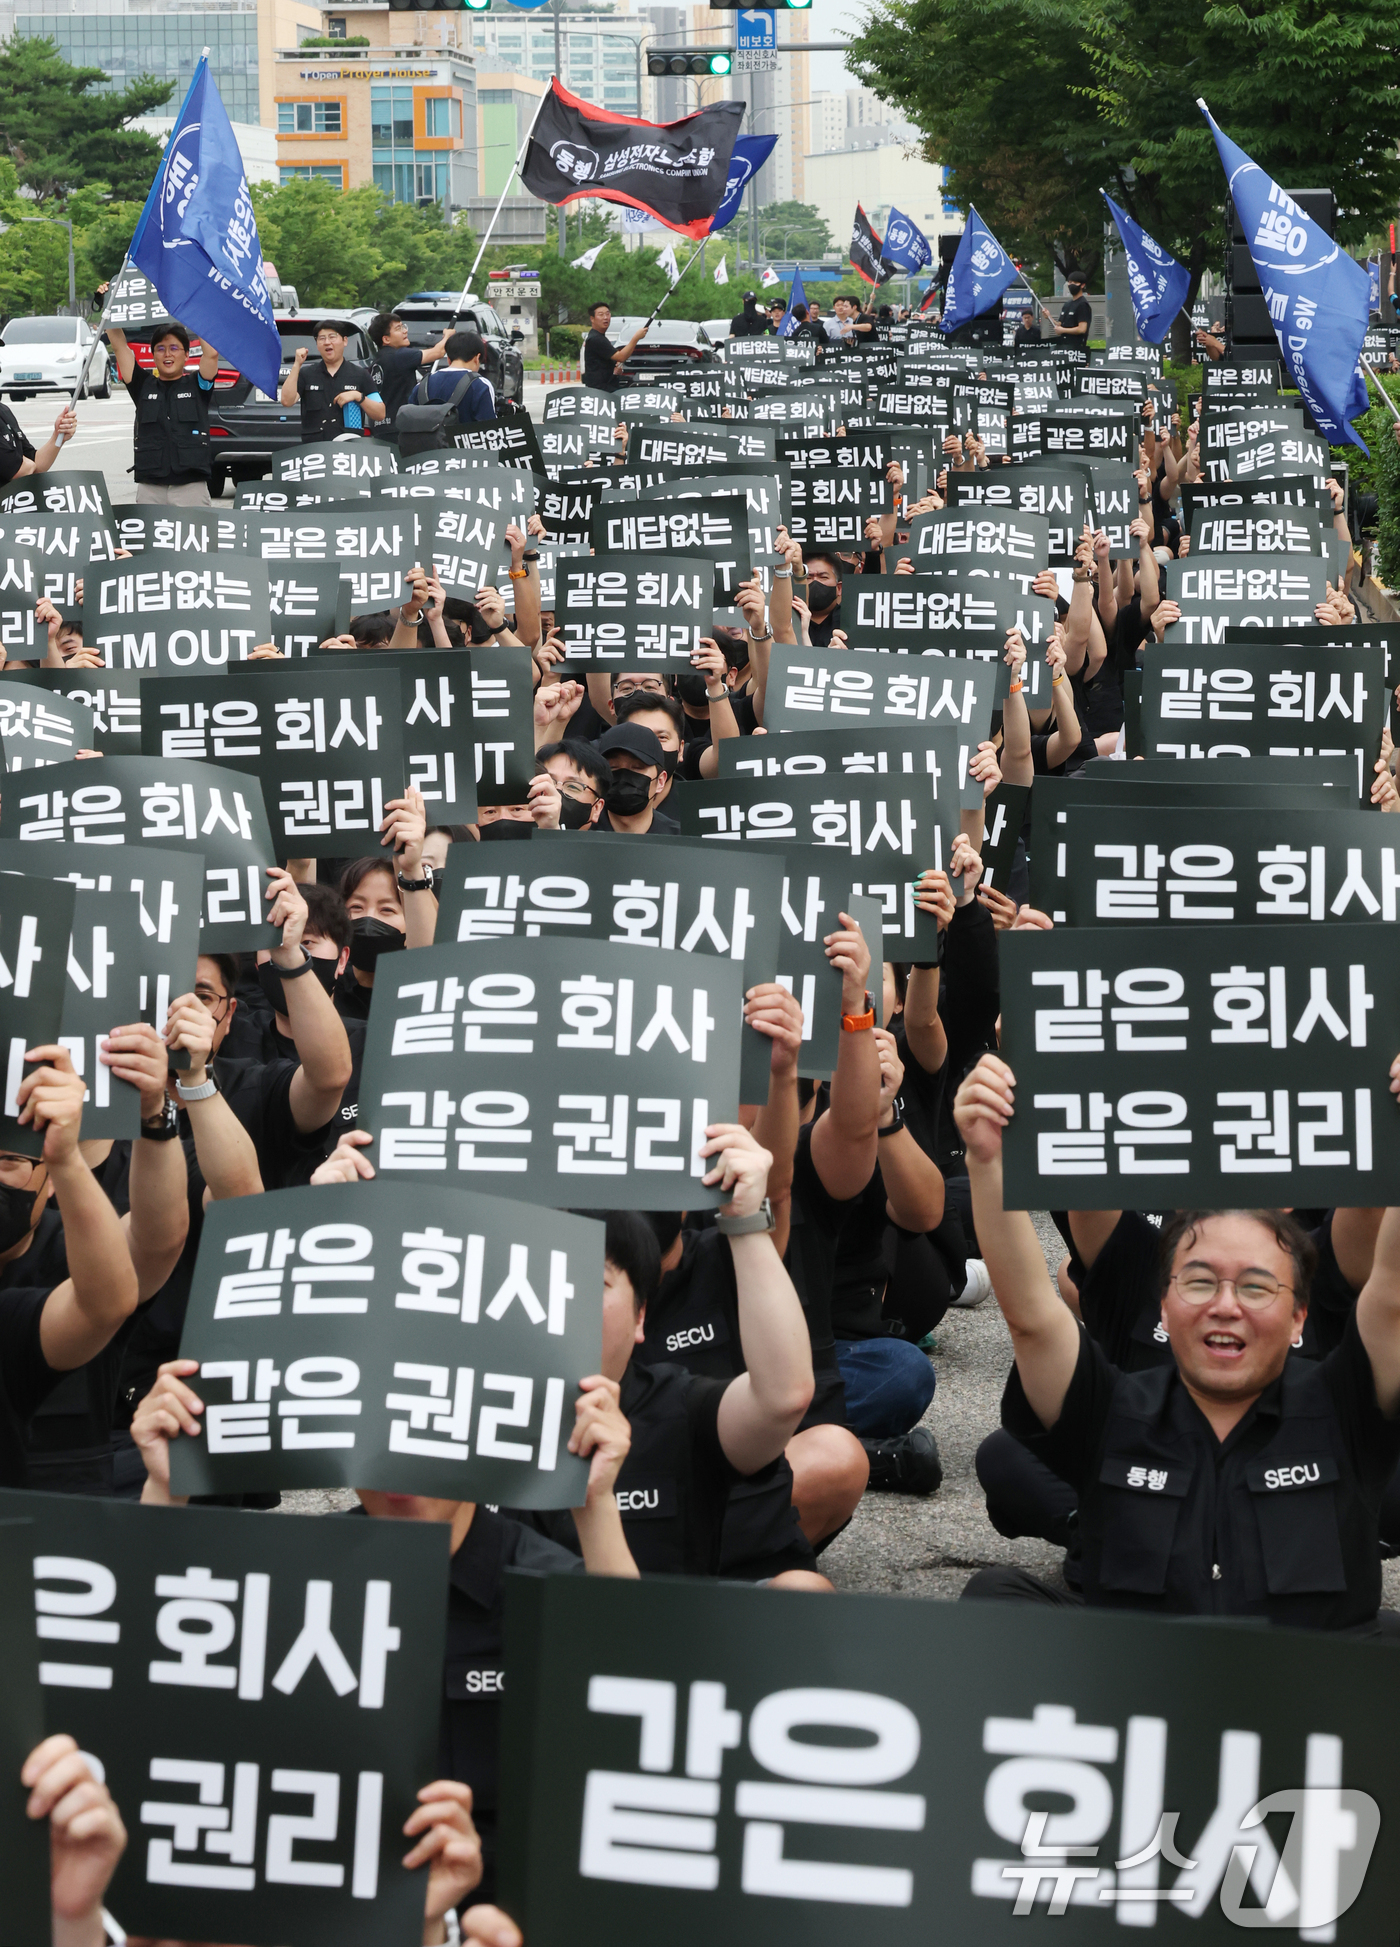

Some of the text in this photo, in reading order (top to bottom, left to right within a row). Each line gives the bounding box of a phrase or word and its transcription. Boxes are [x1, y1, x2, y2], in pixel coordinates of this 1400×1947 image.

[737, 51, 777, 59] 직진신호시
[740, 36, 773, 47] 비보호
[311, 67, 430, 81] Open Prayer House
[737, 61, 777, 70] 좌회전가능
[556, 148, 592, 180] 동행
[493, 287, 538, 296] 안전운전
[110, 302, 146, 322] 같은
[730, 340, 780, 355] 대답없는
[785, 347, 810, 359] 회사
[1108, 346, 1160, 362] 같은 회사
[1362, 335, 1386, 347] 없는
[690, 381, 720, 397] 회사
[1081, 377, 1142, 395] 대답없는
[1208, 369, 1272, 386] 같은 회사
[547, 396, 617, 419] 같은 회사
[644, 394, 677, 413] 회사
[879, 393, 947, 416] 대답없는
[1023, 386, 1052, 400] 회사
[754, 402, 824, 420] 같은 회사
[978, 413, 1005, 428] 회사
[454, 426, 527, 451] 대답없는
[543, 433, 583, 456] 회사
[1047, 425, 1127, 450] 같은 회사
[281, 452, 382, 481] 같은 회사
[641, 440, 727, 466] 대답없는
[837, 446, 883, 469] 회사
[1237, 440, 1324, 474] 같은 회사
[43, 485, 103, 515] 회사
[812, 479, 862, 505] 회사
[1019, 484, 1073, 514] 회사
[543, 493, 593, 521] 회사
[115, 518, 209, 552] 은 회사
[260, 525, 403, 559] 같은 회사
[434, 511, 496, 551] 회사
[608, 512, 732, 550] 대답없는
[814, 516, 862, 542] 권리
[918, 520, 1036, 559] 대답없는
[1048, 527, 1073, 556] 리
[1199, 519, 1311, 552] 대답없는
[432, 554, 488, 592] 권리
[1182, 569, 1310, 601] 대답없는
[100, 570, 251, 615] 대답없는
[567, 571, 628, 608] 같은
[636, 571, 703, 609] 회사
[857, 592, 998, 631] 대답없는
[97, 631, 157, 669] TM
[168, 629, 256, 666] OUT
[564, 622, 701, 660] 같은 권리
[784, 666, 978, 724] 같은 회사
[1160, 668, 1368, 723] 같은 회사
[160, 696, 383, 758] 같은 회사
[20, 782, 252, 845] 같은 회사
[279, 777, 384, 836] 권리
[810, 799, 917, 856] 회사
[1094, 844, 1400, 922] 같은 회사
[457, 875, 756, 960] 같은 회사
[391, 973, 715, 1063] 같은 회사
[1031, 964, 1374, 1053] 같은 회사
[341, 1104, 359, 1121] SE
[379, 1090, 708, 1178] 같은 권리
[1034, 1088, 1373, 1175] 같은 권리
[213, 1222, 575, 1336] 같은 회사
[665, 1323, 715, 1352] SECU
[201, 1356, 566, 1471] 같은 권리
[1126, 1466, 1168, 1491] 동행
[1264, 1463, 1320, 1490] SECU
[616, 1488, 660, 1511] ECU
[34, 1556, 401, 1709] 은 회사
[578, 1673, 1358, 1944] 같은 회사
[140, 1757, 383, 1900] 권리
